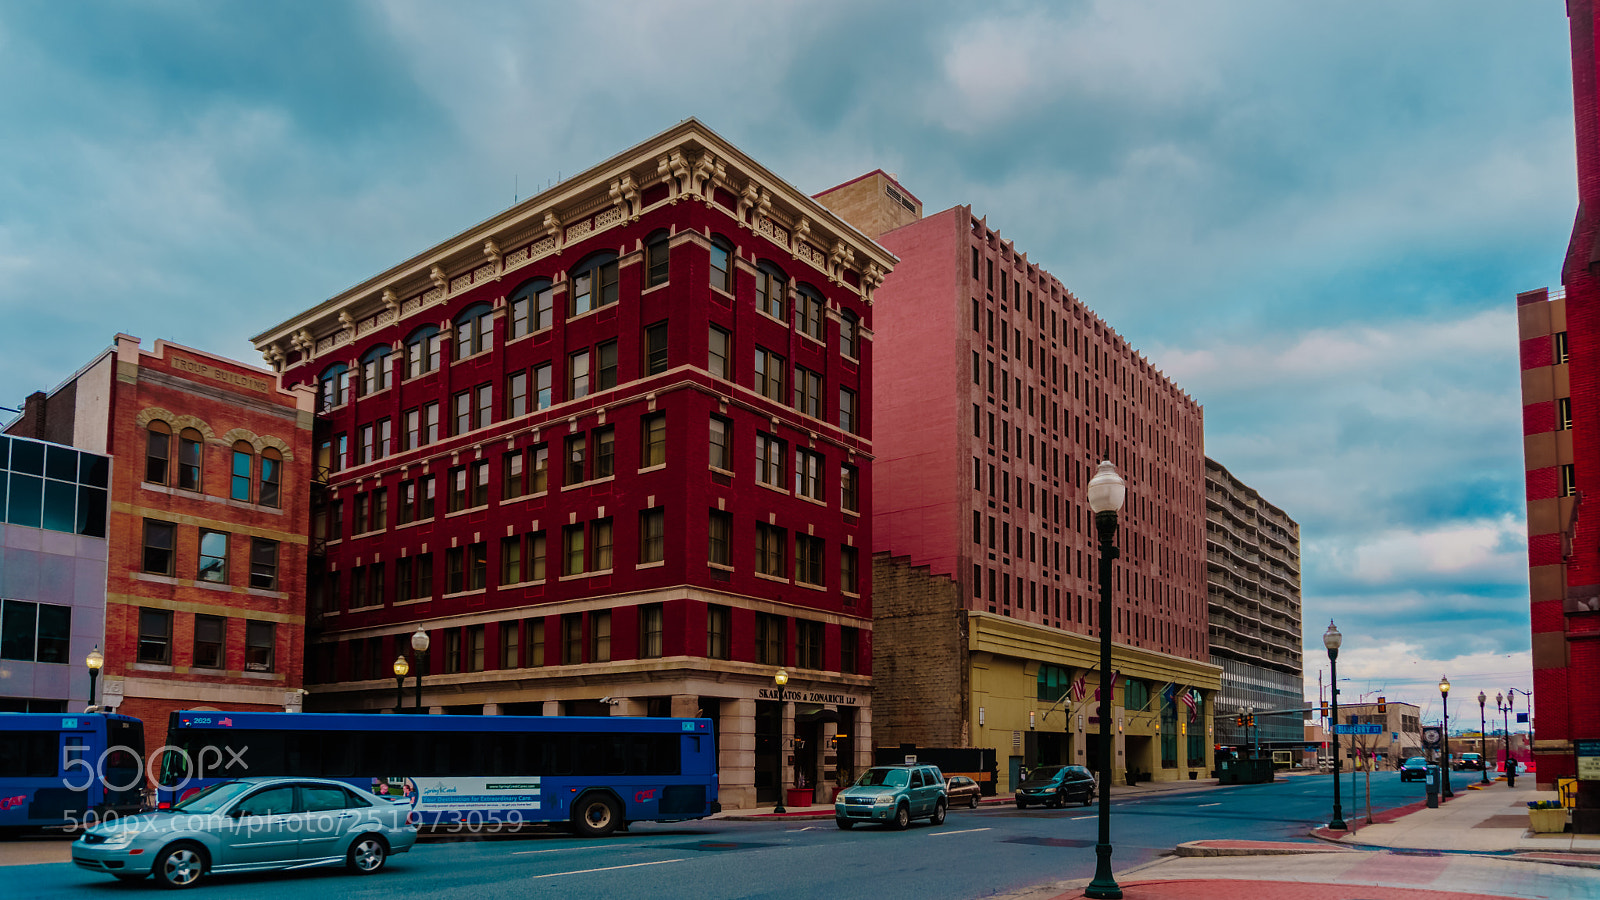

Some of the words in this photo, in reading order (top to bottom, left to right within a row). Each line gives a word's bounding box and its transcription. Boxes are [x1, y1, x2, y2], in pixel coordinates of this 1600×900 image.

[173, 357, 208, 375] TROUP
[214, 369, 267, 392] BUILDING
[759, 688, 801, 700] SKARATOS
[802, 693, 807, 701] &
[809, 692, 844, 704] ZONARICH
[846, 697, 856, 705] LLP
[423, 786, 440, 796] Spring
[634, 789, 656, 803] CAT
[480, 795, 518, 803] Extraordinary
